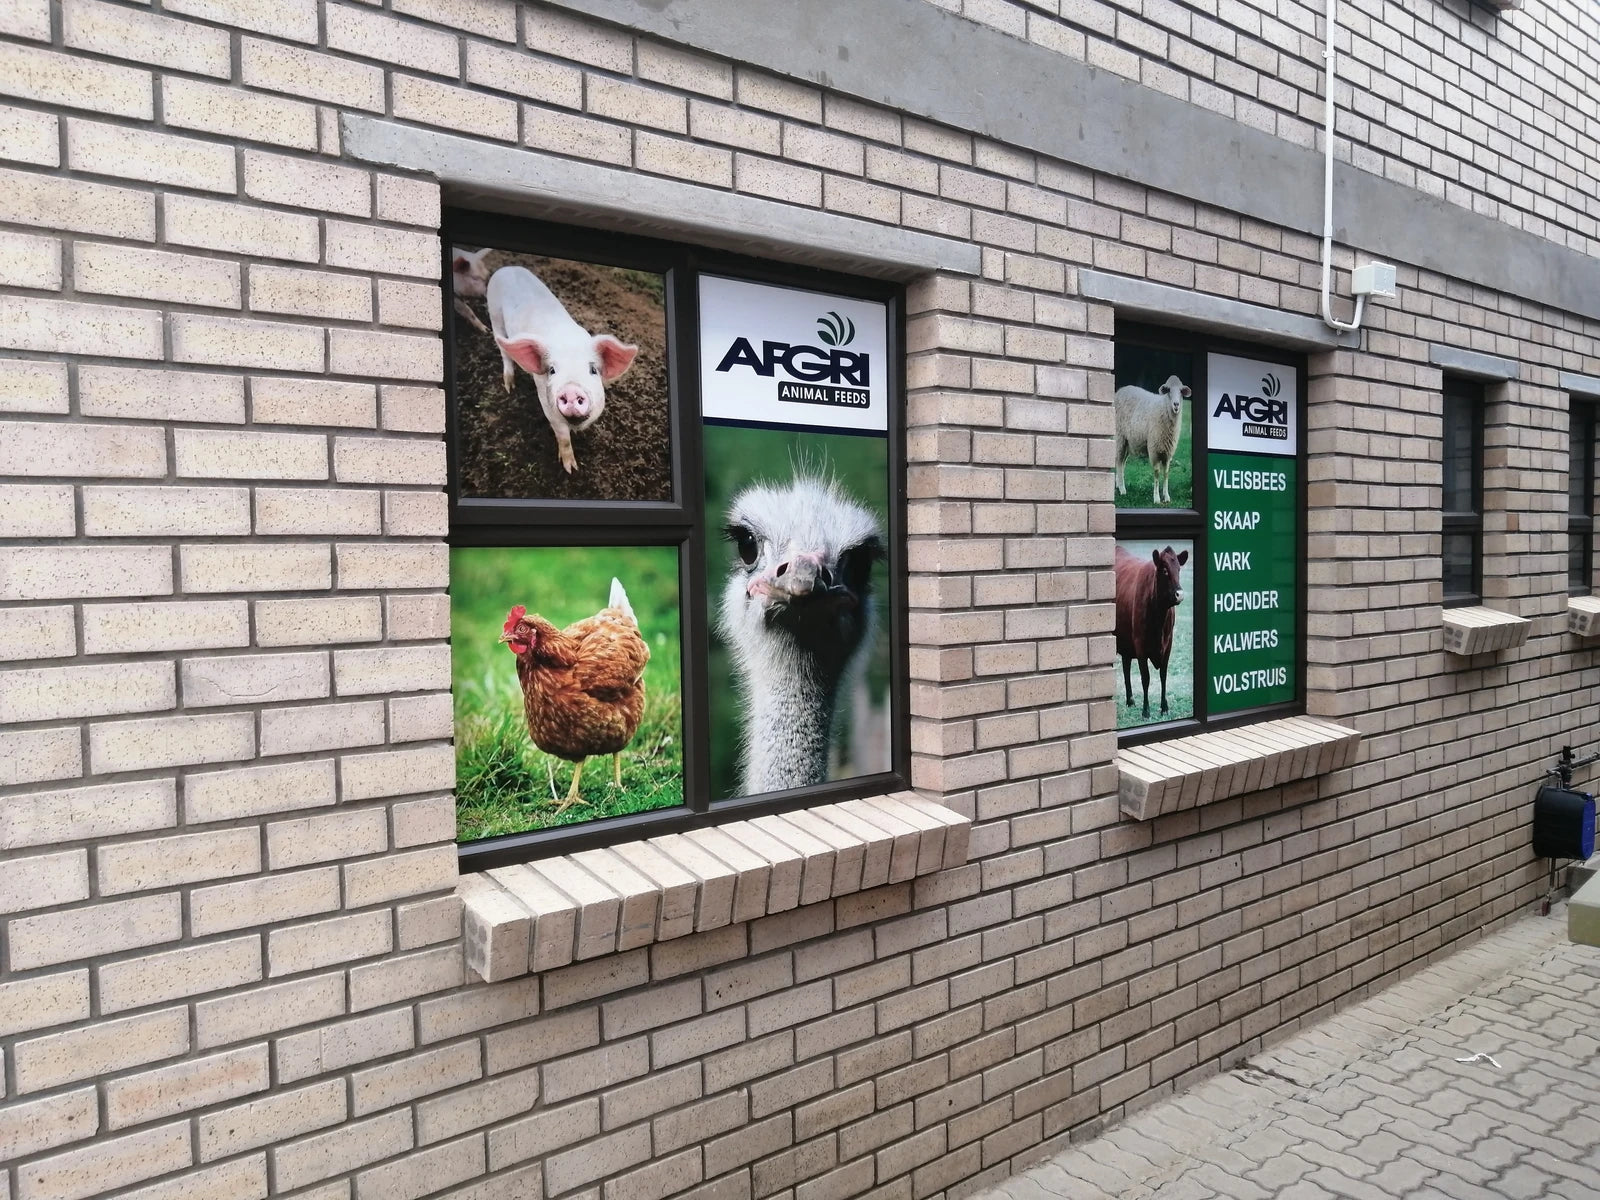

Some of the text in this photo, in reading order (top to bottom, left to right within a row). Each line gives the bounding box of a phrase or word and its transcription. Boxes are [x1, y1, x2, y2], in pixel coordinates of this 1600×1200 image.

[716, 337, 870, 387] AFGRI
[782, 385, 867, 405] ANIMAL FEEDS
[1213, 393, 1288, 425] AFGRI
[1244, 425, 1286, 438] ANIMAL FEEDS
[1214, 469, 1287, 491] VLEISBEES
[1214, 511, 1260, 530] SKAAP
[1214, 552, 1251, 571] VARK
[1214, 590, 1279, 613] HOENDER
[1214, 629, 1279, 654] KALWERS
[1213, 666, 1287, 695] VOLSTRUIS
